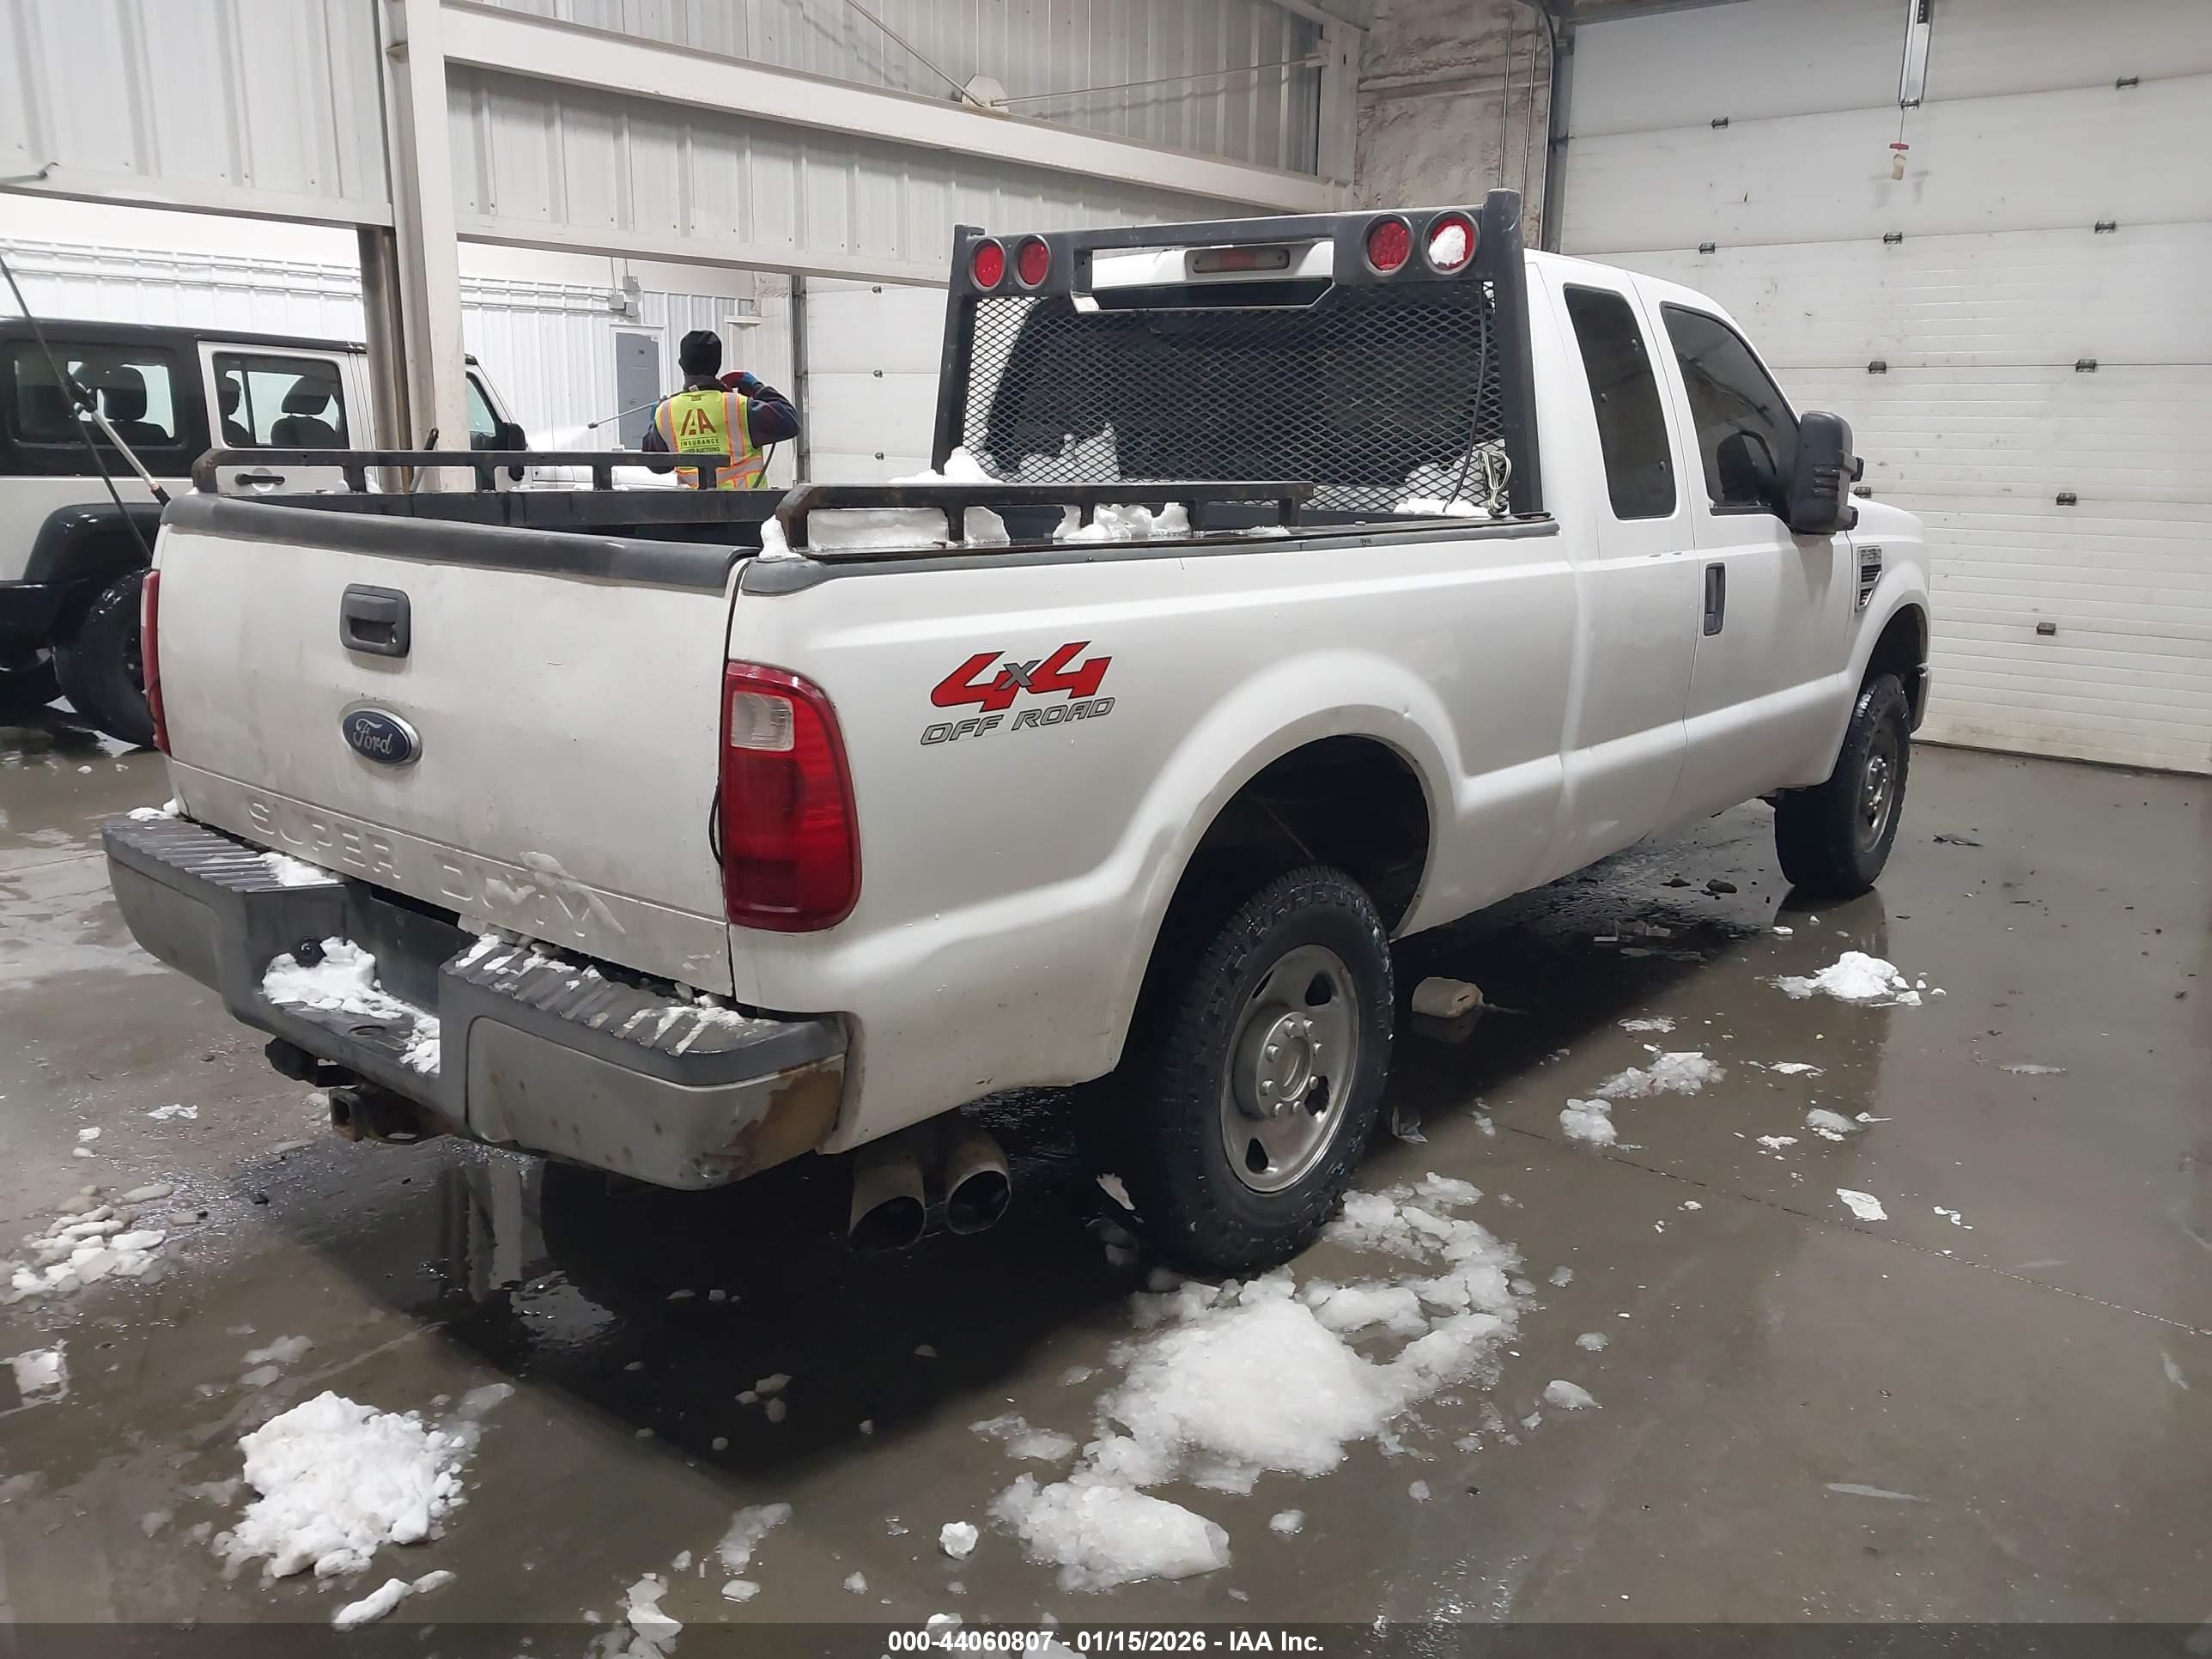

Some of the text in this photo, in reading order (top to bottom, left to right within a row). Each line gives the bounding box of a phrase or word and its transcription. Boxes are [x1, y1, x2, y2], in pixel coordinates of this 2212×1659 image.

[680, 438, 720, 447] INSURANCE
[353, 718, 393, 755] Ford
[920, 696, 1115, 745] OFF ROAD
[246, 794, 402, 880] SUPER
